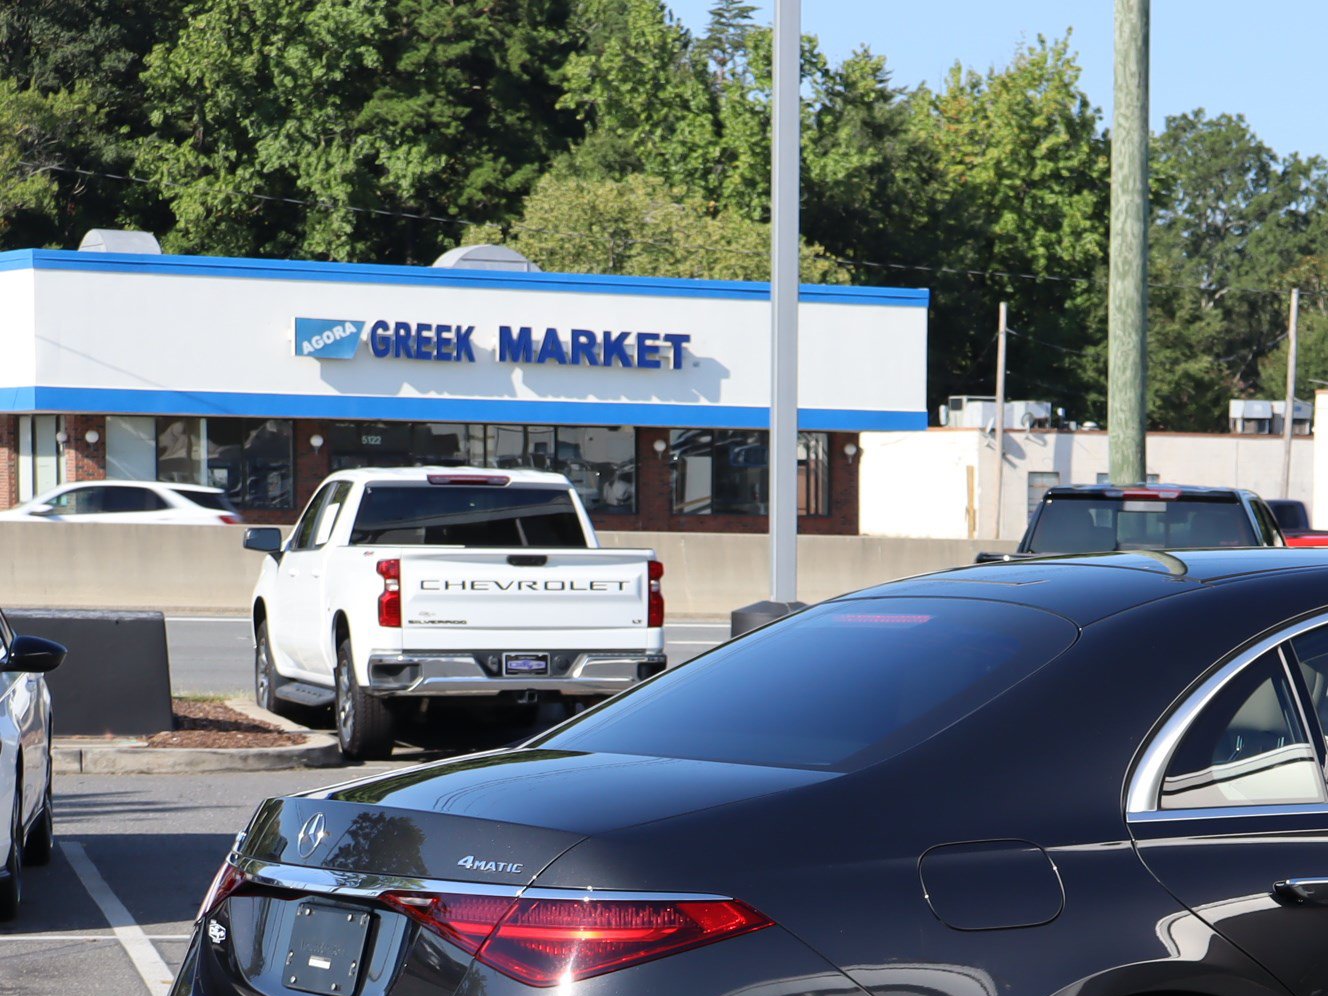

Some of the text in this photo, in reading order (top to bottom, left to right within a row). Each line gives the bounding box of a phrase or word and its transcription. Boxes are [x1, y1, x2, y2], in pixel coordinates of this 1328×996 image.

[301, 321, 357, 355] AGORA
[370, 319, 691, 370] GREEK MARKET
[361, 435, 382, 445] 5122
[421, 579, 630, 592] CHEVROLET
[457, 855, 524, 873] 4MATIC
